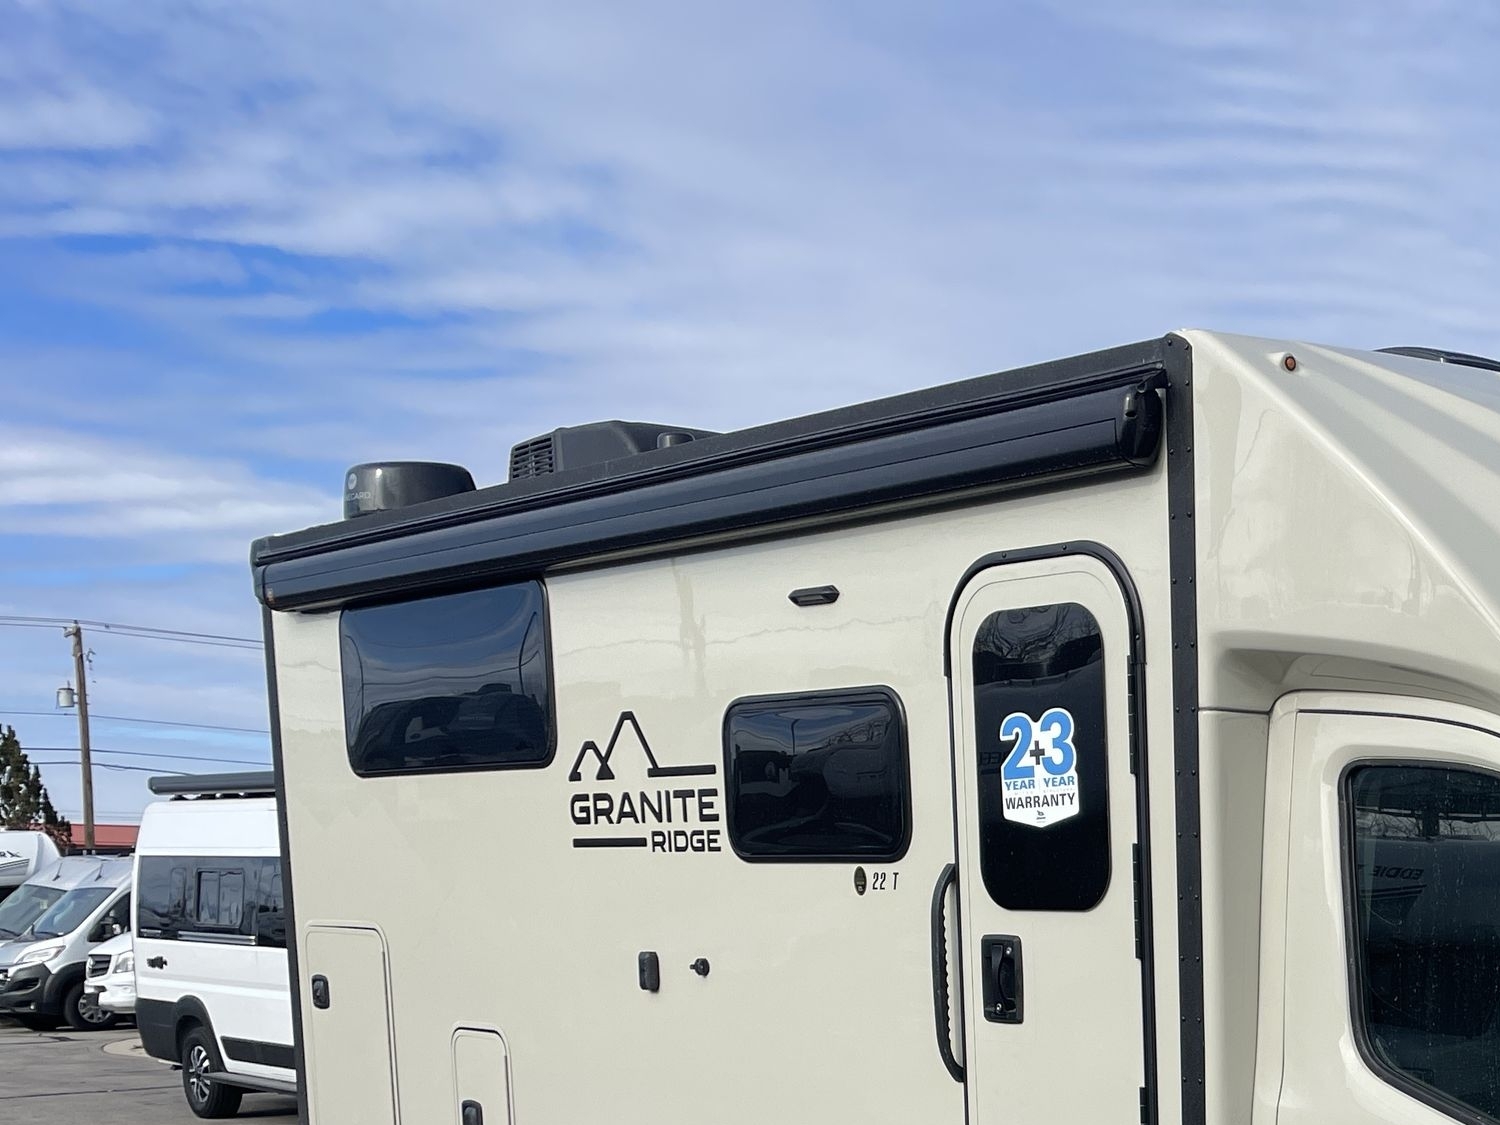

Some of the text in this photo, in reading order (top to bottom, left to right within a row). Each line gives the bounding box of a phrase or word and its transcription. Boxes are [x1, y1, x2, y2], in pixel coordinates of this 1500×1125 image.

[1004, 779, 1035, 791] YEAR
[1043, 775, 1075, 788] YEAR
[570, 788, 720, 825] GRANITE
[1005, 793, 1076, 810] WARRANTY
[652, 830, 721, 852] RIDGE
[872, 871, 900, 890] 22 T
